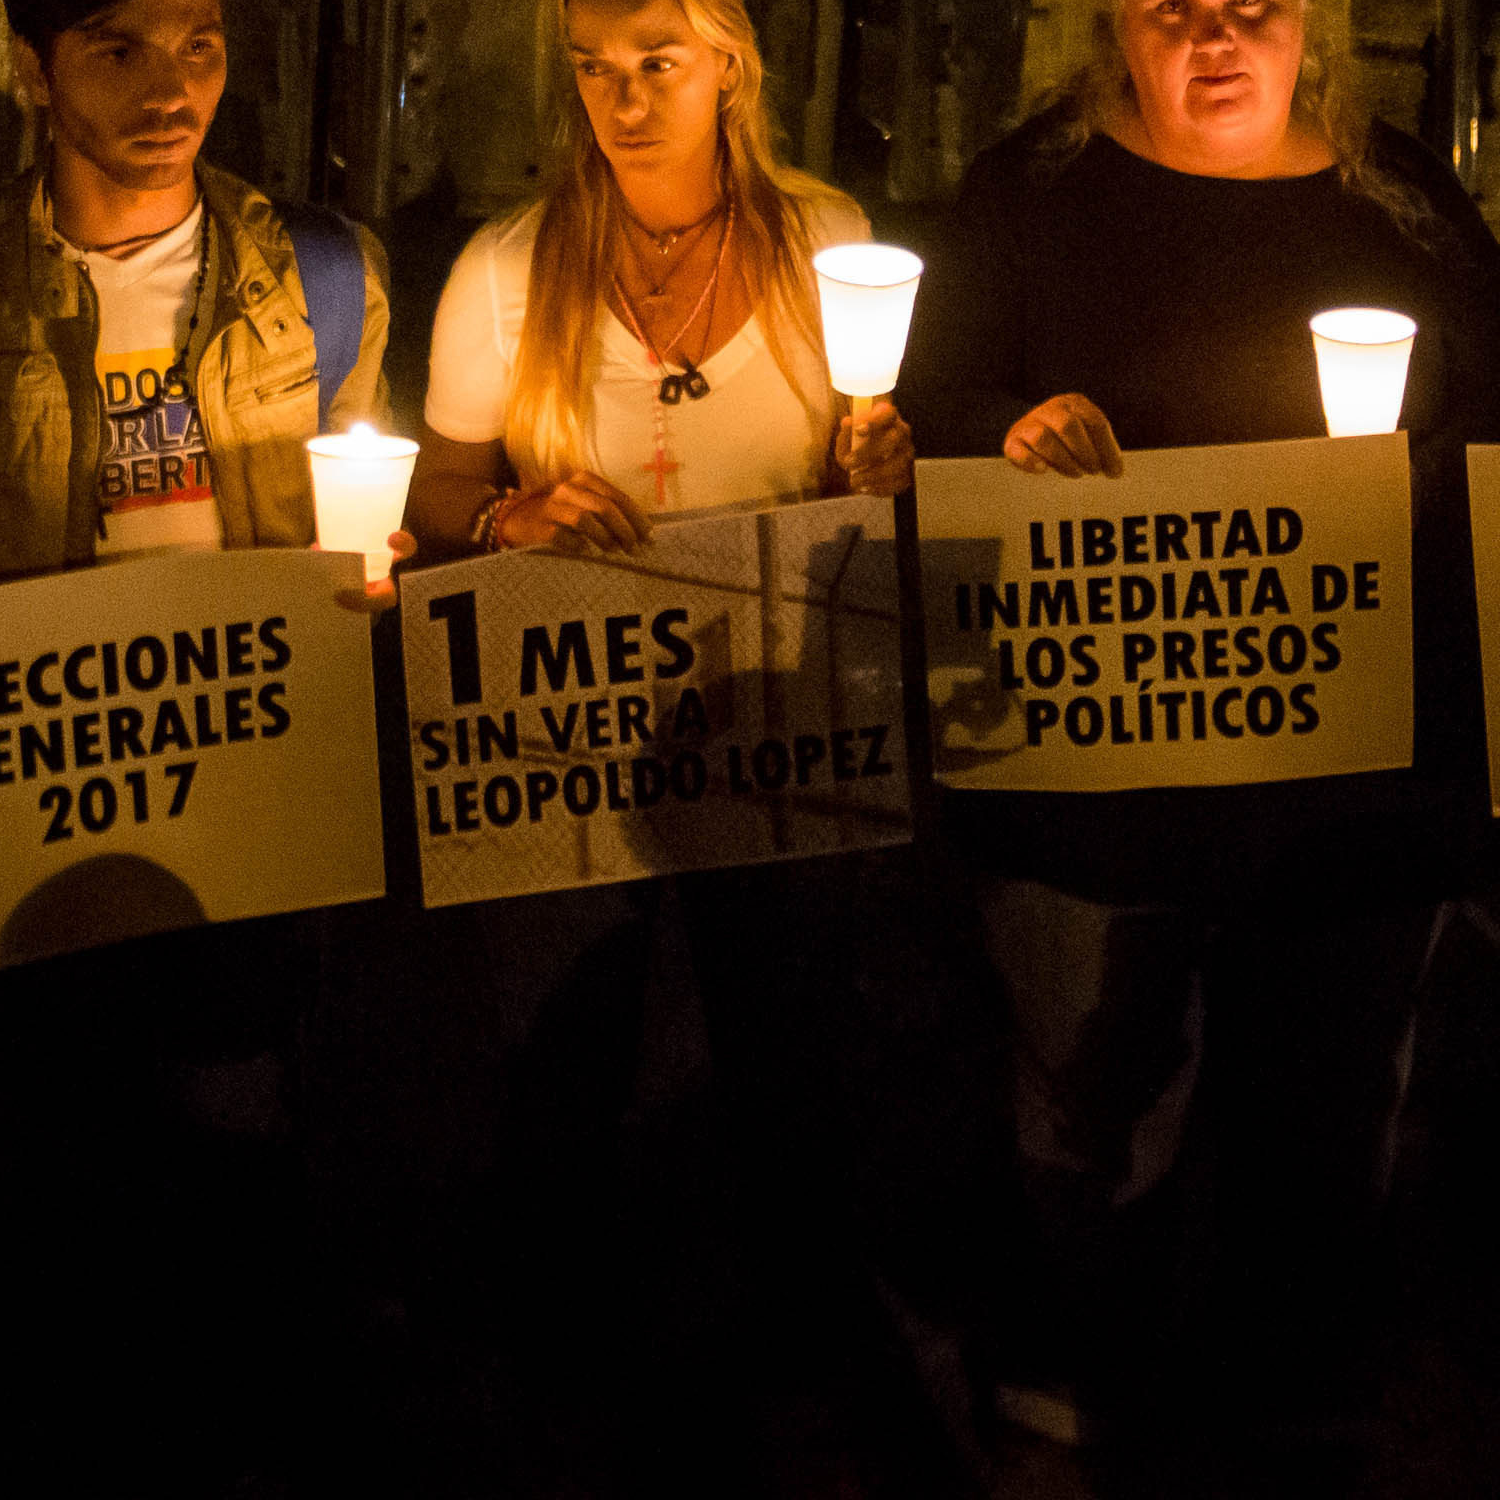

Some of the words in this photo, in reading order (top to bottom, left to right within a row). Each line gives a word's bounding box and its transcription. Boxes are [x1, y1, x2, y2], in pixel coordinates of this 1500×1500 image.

[1029, 506, 1305, 571] LIBERTAD
[955, 566, 1291, 631] INMEDIATA
[1311, 560, 1382, 614] DE
[428, 590, 486, 707] 1
[518, 607, 697, 698] MES
[999, 633, 1101, 692] LOS
[1122, 621, 1343, 684] PRESOS
[418, 708, 519, 773] SIN
[540, 693, 655, 755] VER
[673, 686, 712, 743] A
[1025, 680, 1321, 748] POLÍTICOS
[38, 760, 200, 846] 2017
[424, 752, 710, 838] LEOPOLDO
[727, 722, 895, 797] LOPEZ
